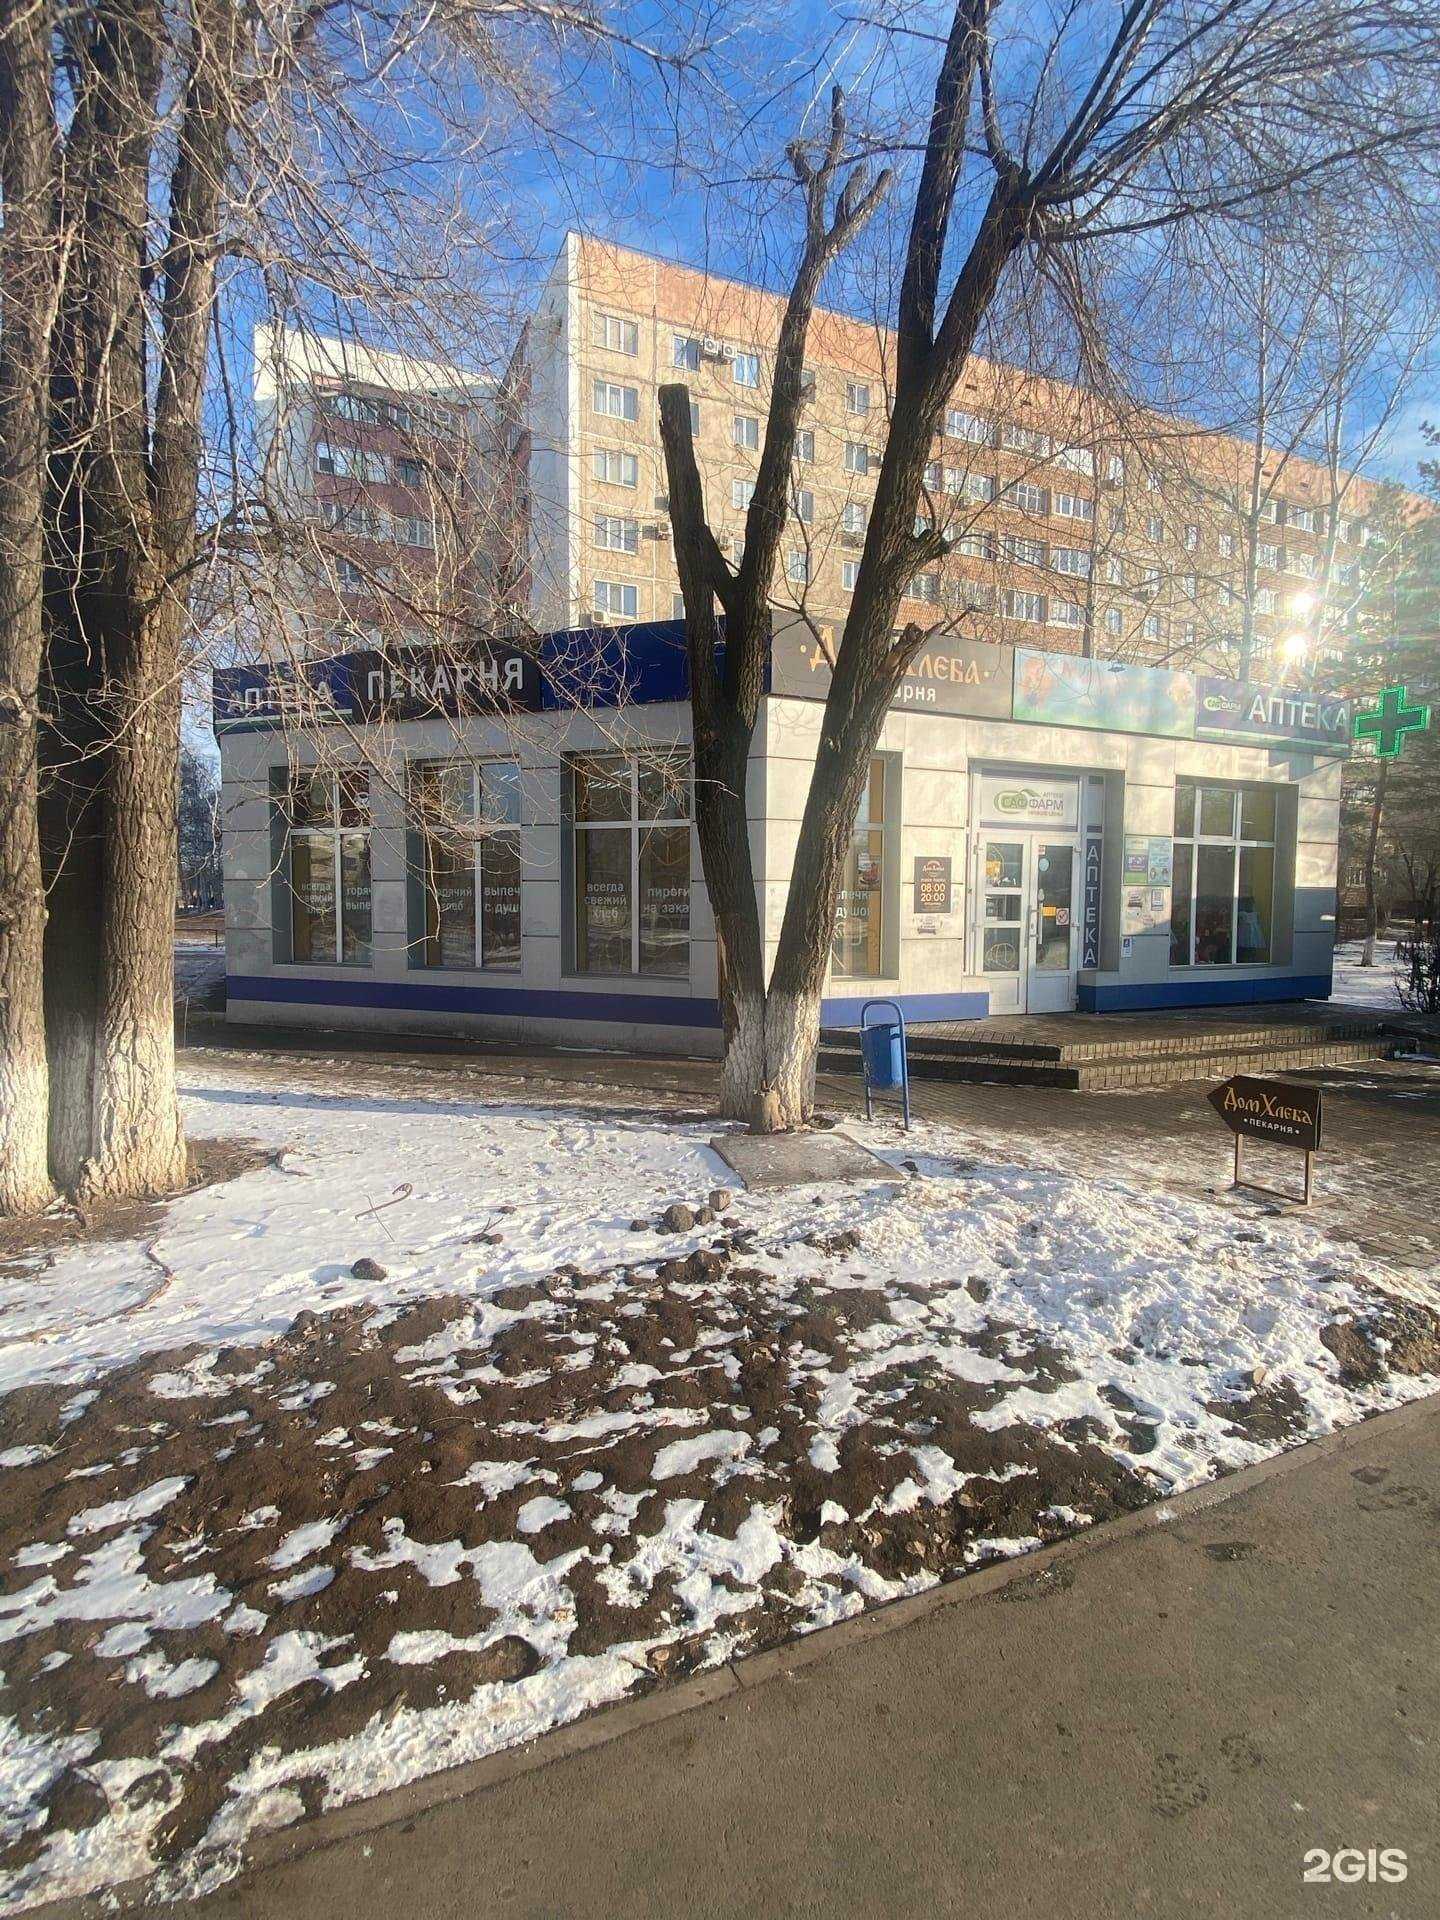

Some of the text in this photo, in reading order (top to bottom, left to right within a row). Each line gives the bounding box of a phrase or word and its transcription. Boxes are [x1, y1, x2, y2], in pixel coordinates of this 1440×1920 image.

[367, 657, 523, 701] ПЕКАРНЯ
[1248, 694, 1347, 731] АПТЕКА
[587, 883, 625, 893] всегда
[921, 893, 946, 902] 20:00
[1084, 845, 1099, 964] АПТЕКА
[1249, 1118, 1293, 1134] ПЕКАРНЯ
